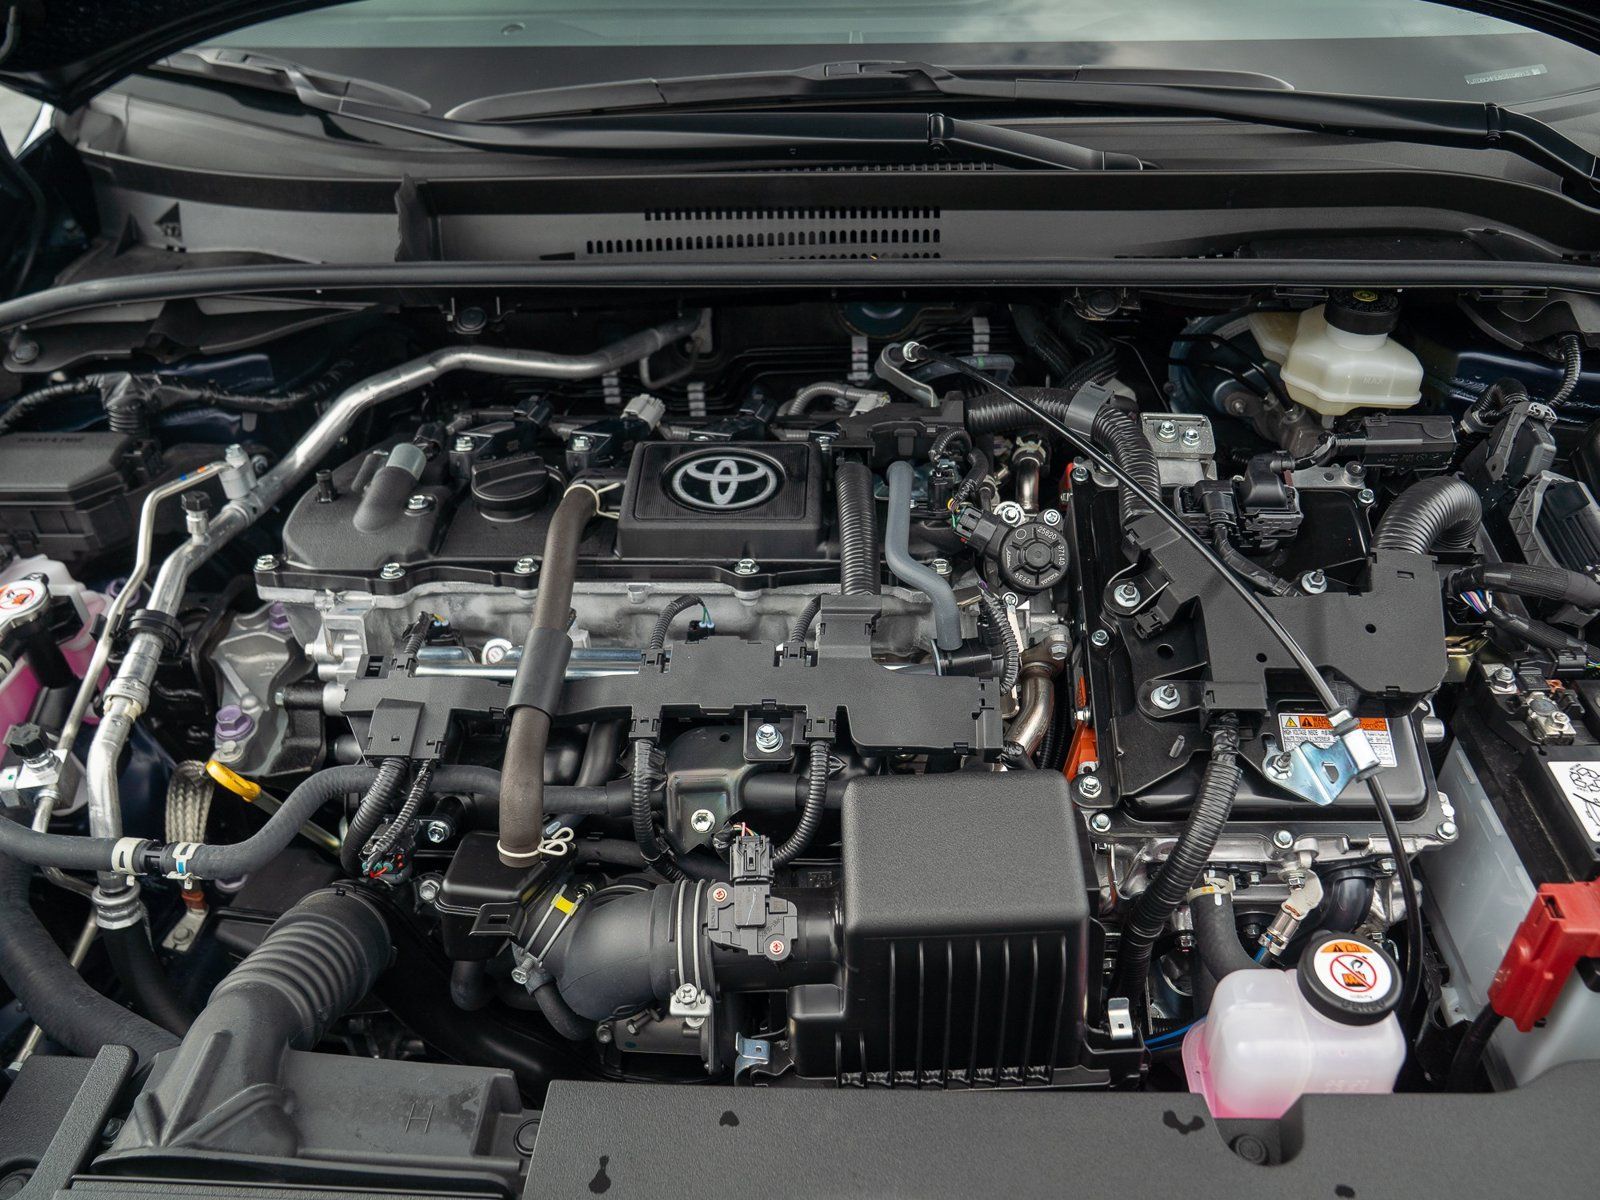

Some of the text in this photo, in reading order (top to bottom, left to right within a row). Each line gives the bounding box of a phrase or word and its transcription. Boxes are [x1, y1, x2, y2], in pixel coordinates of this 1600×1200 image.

[1037, 526, 1057, 540] 25620
[1058, 545, 1066, 566] 37140
[1040, 572, 1060, 585] TOYOTA
